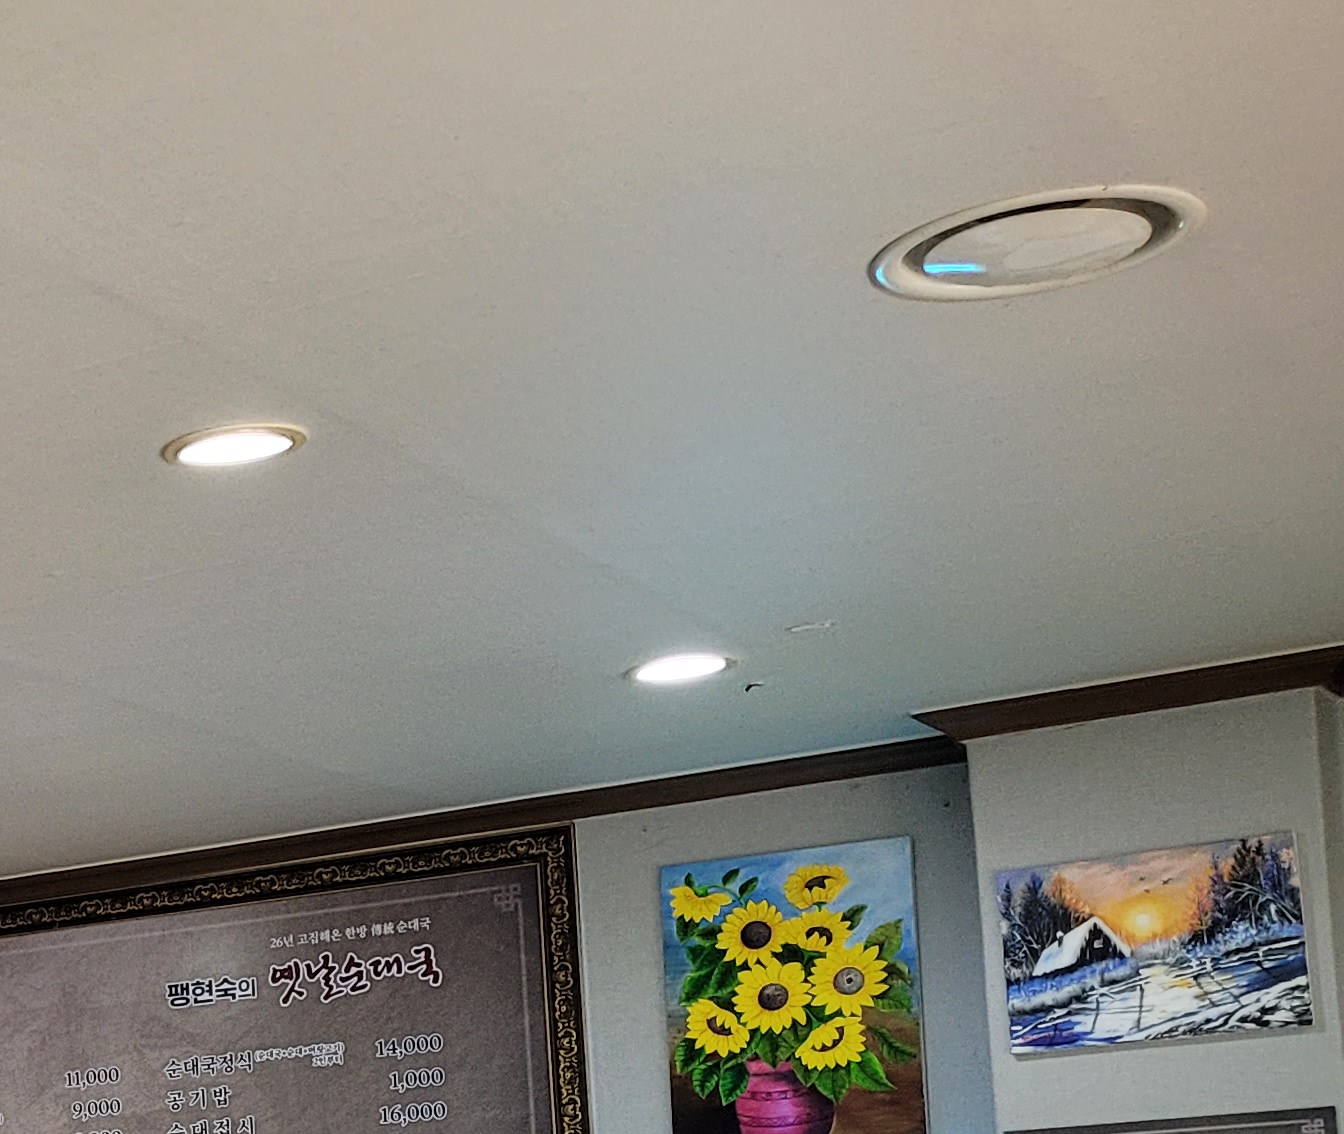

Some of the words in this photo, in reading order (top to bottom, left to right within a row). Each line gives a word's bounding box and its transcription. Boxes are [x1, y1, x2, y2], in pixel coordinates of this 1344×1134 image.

[270, 934, 294, 948] 26년
[345, 925, 368, 940] 한방
[396, 917, 432, 933] 순대국
[166, 977, 257, 1008] 팽현숙의
[375, 1034, 443, 1060] 14,000
[164, 1050, 254, 1079] 순대국정식
[64, 1067, 120, 1089] 11,000
[389, 1068, 445, 1093] 1,000
[72, 1099, 121, 1121] 9,000
[379, 1102, 447, 1126] 16,000
